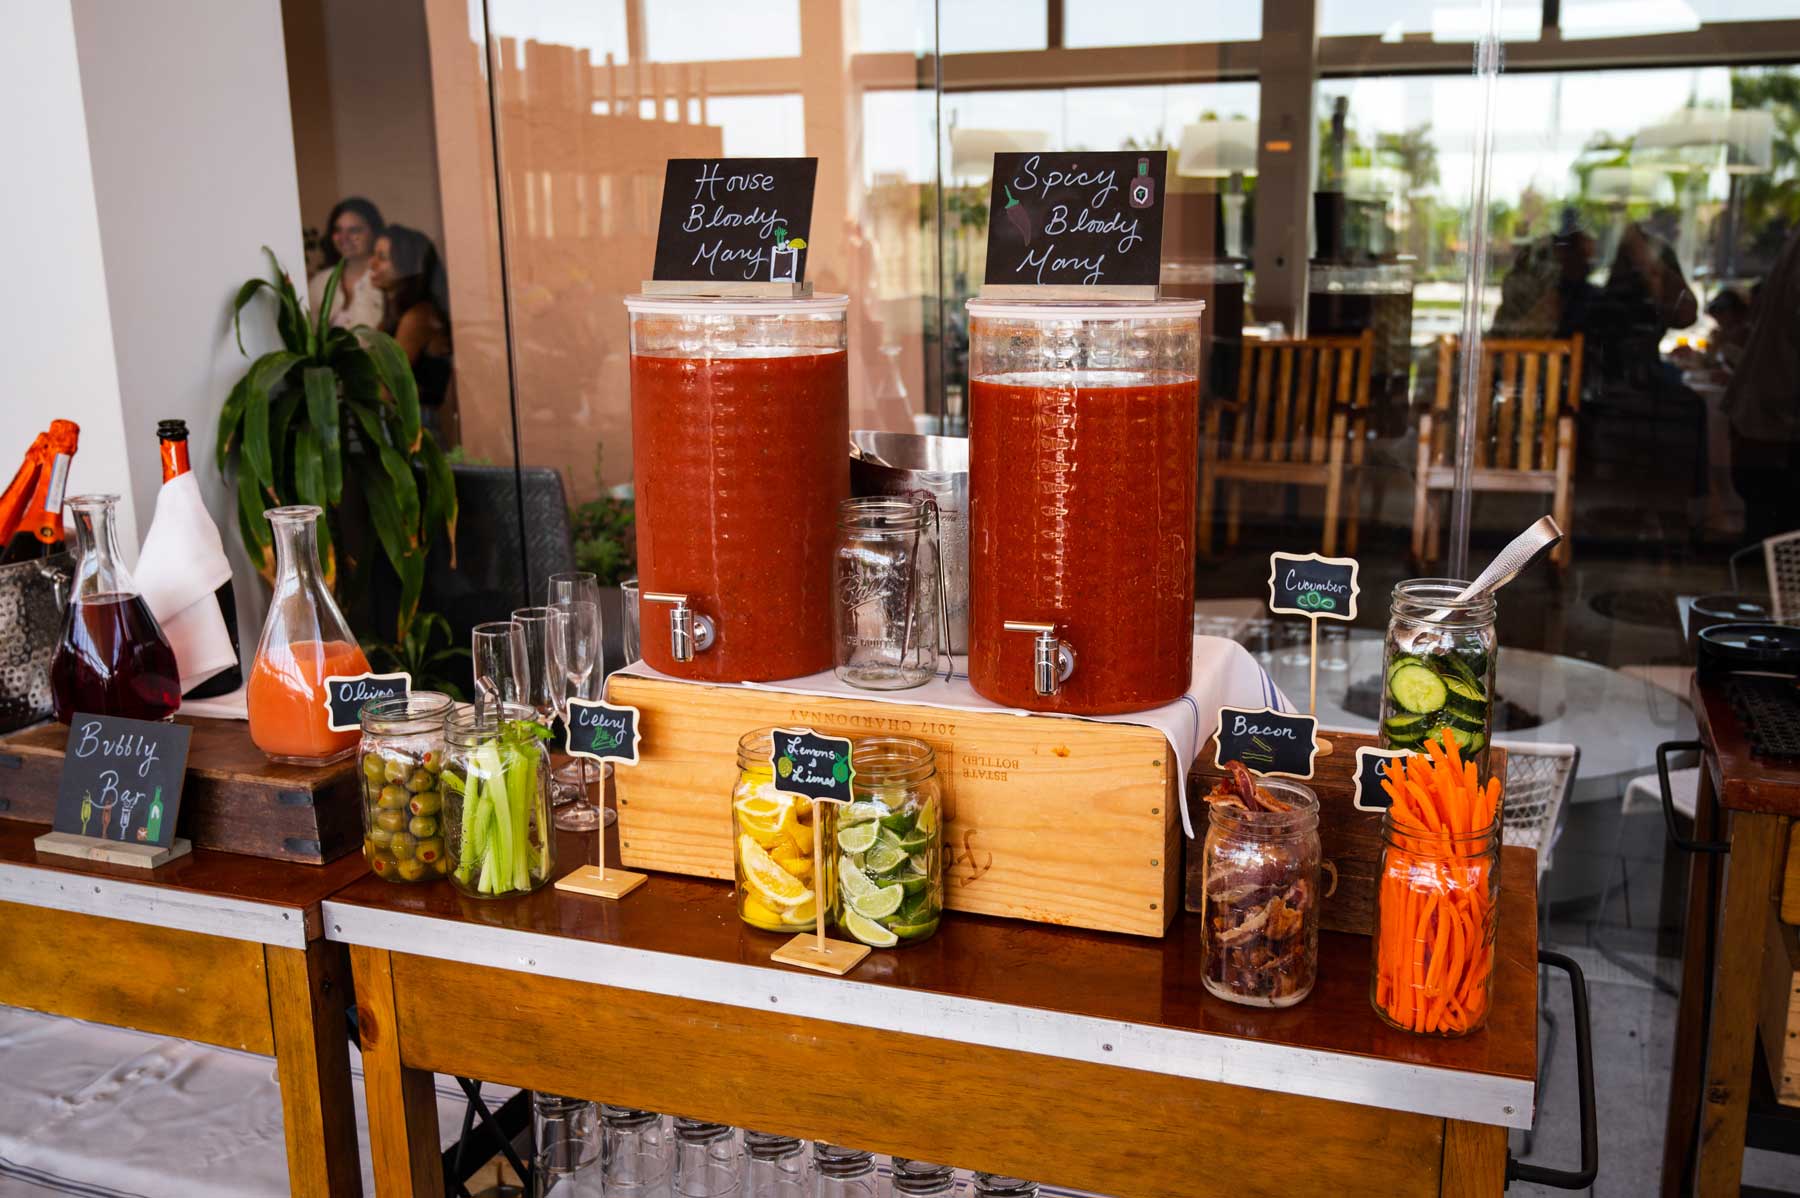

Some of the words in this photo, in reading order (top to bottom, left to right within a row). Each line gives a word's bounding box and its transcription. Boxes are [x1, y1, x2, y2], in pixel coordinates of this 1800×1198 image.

[695, 163, 775, 200] House
[1013, 155, 1119, 208] Spicy
[682, 203, 788, 239] Bloody
[1044, 205, 1142, 253] Bloody
[692, 240, 769, 280] Mary
[1016, 244, 1105, 285] Mary
[1285, 568, 1347, 593] Cucumber
[340, 681, 394, 701] Olives
[579, 708, 627, 744] Celery
[789, 709, 912, 731] CHARDONNAY
[921, 722, 956, 736] 2017
[1231, 715, 1296, 739] Bacon
[75, 721, 159, 777] Bubbly
[787, 736, 836, 760] Lemons
[962, 755, 1019, 769] BOTTLED
[90, 770, 146, 809] Bar
[791, 765, 836, 787] Limes
[963, 768, 1008, 782] ESTATE
